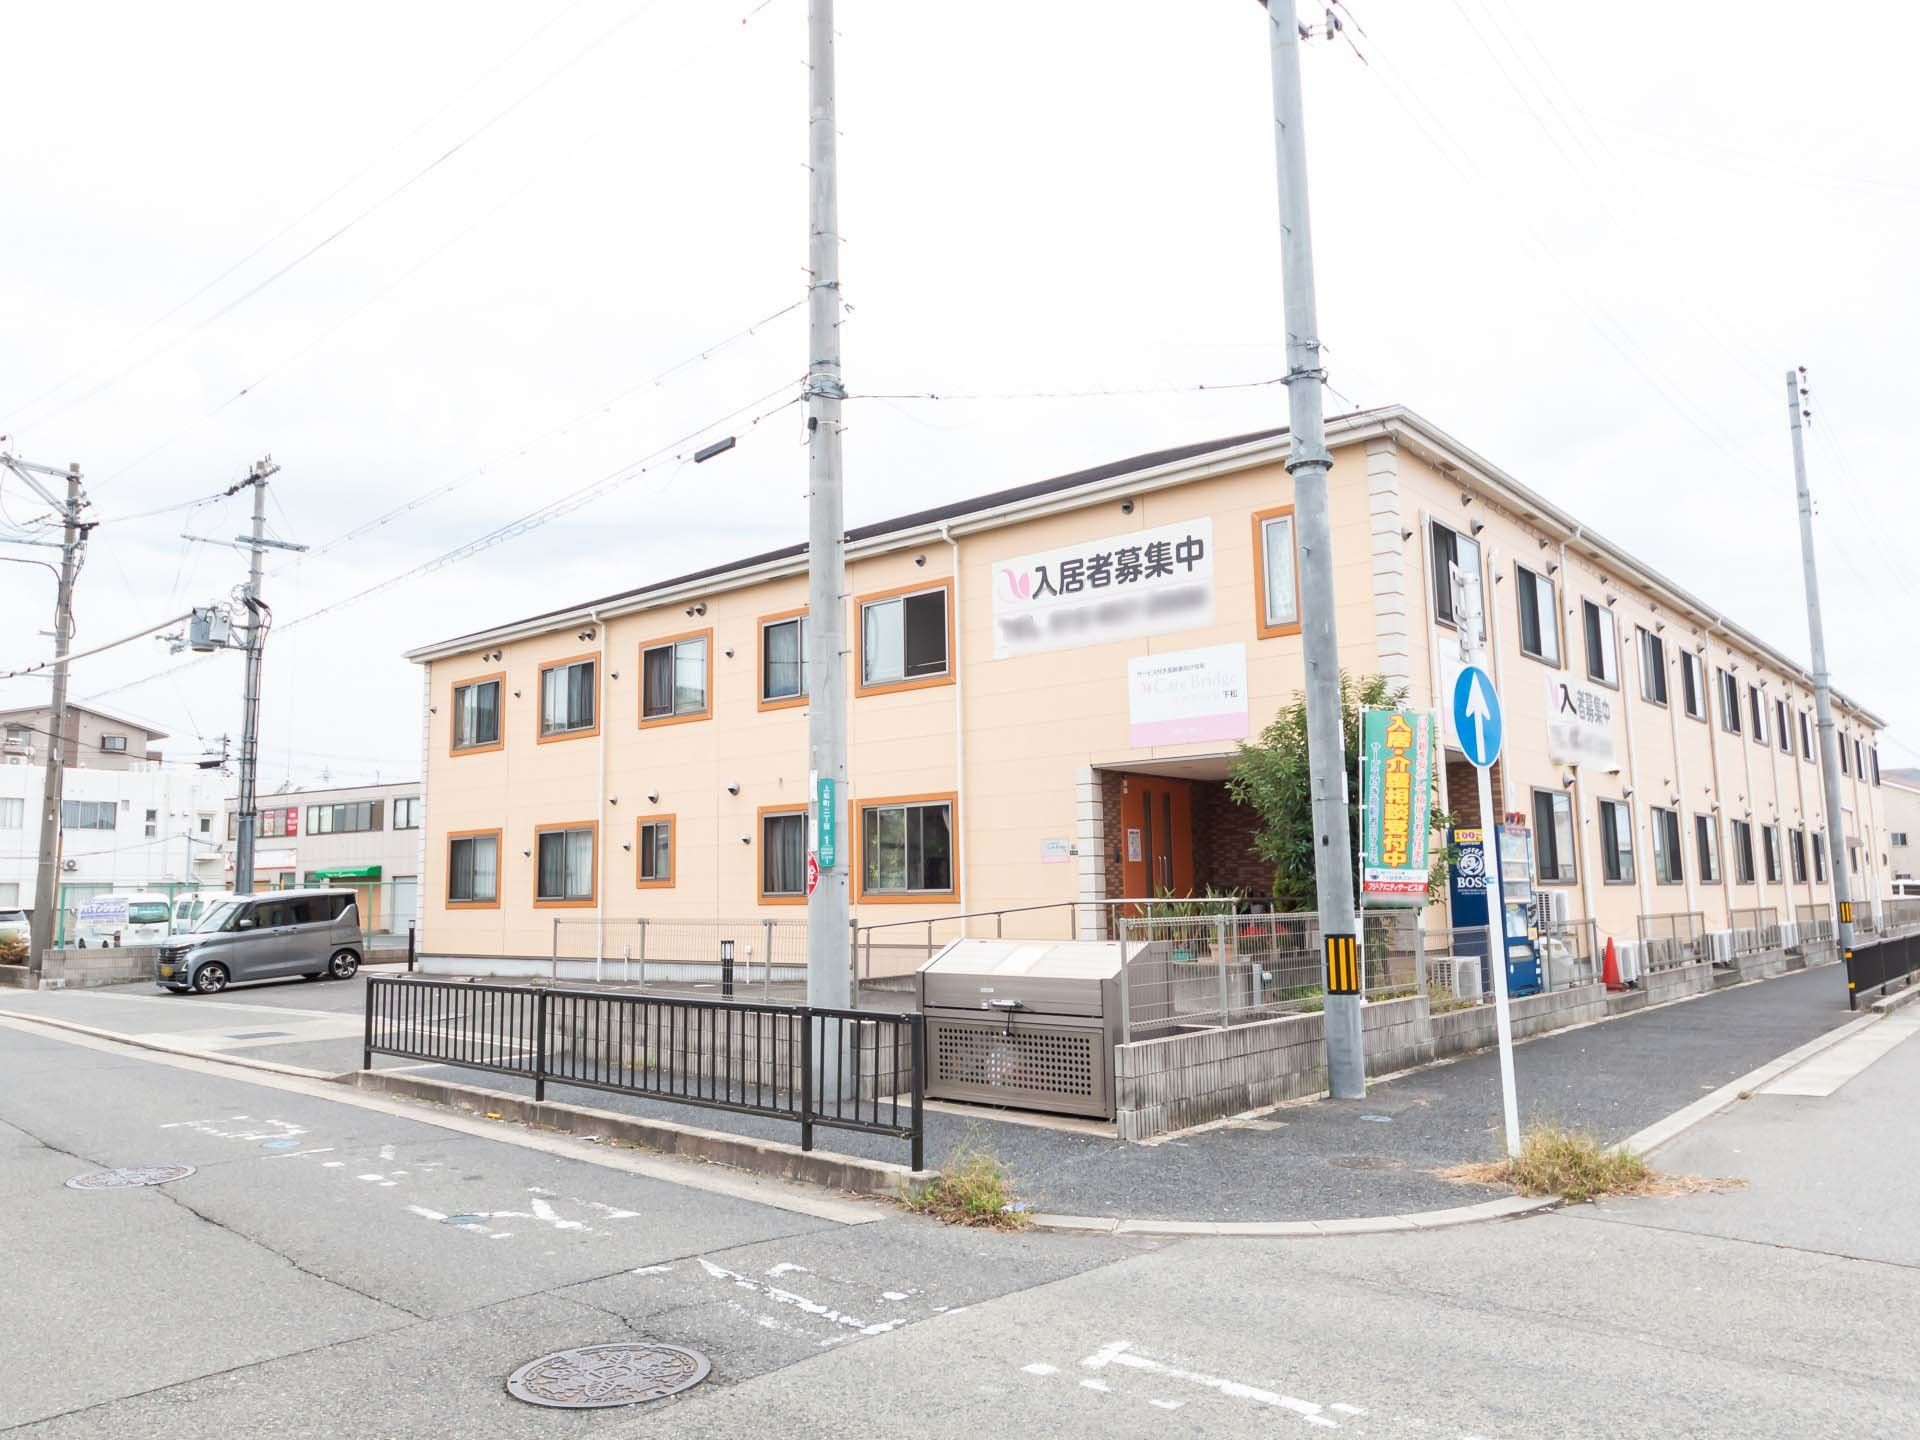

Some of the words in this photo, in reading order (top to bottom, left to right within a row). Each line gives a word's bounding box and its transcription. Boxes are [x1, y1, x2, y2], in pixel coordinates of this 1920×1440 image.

[1032, 535, 1204, 600] 入居者募集中
